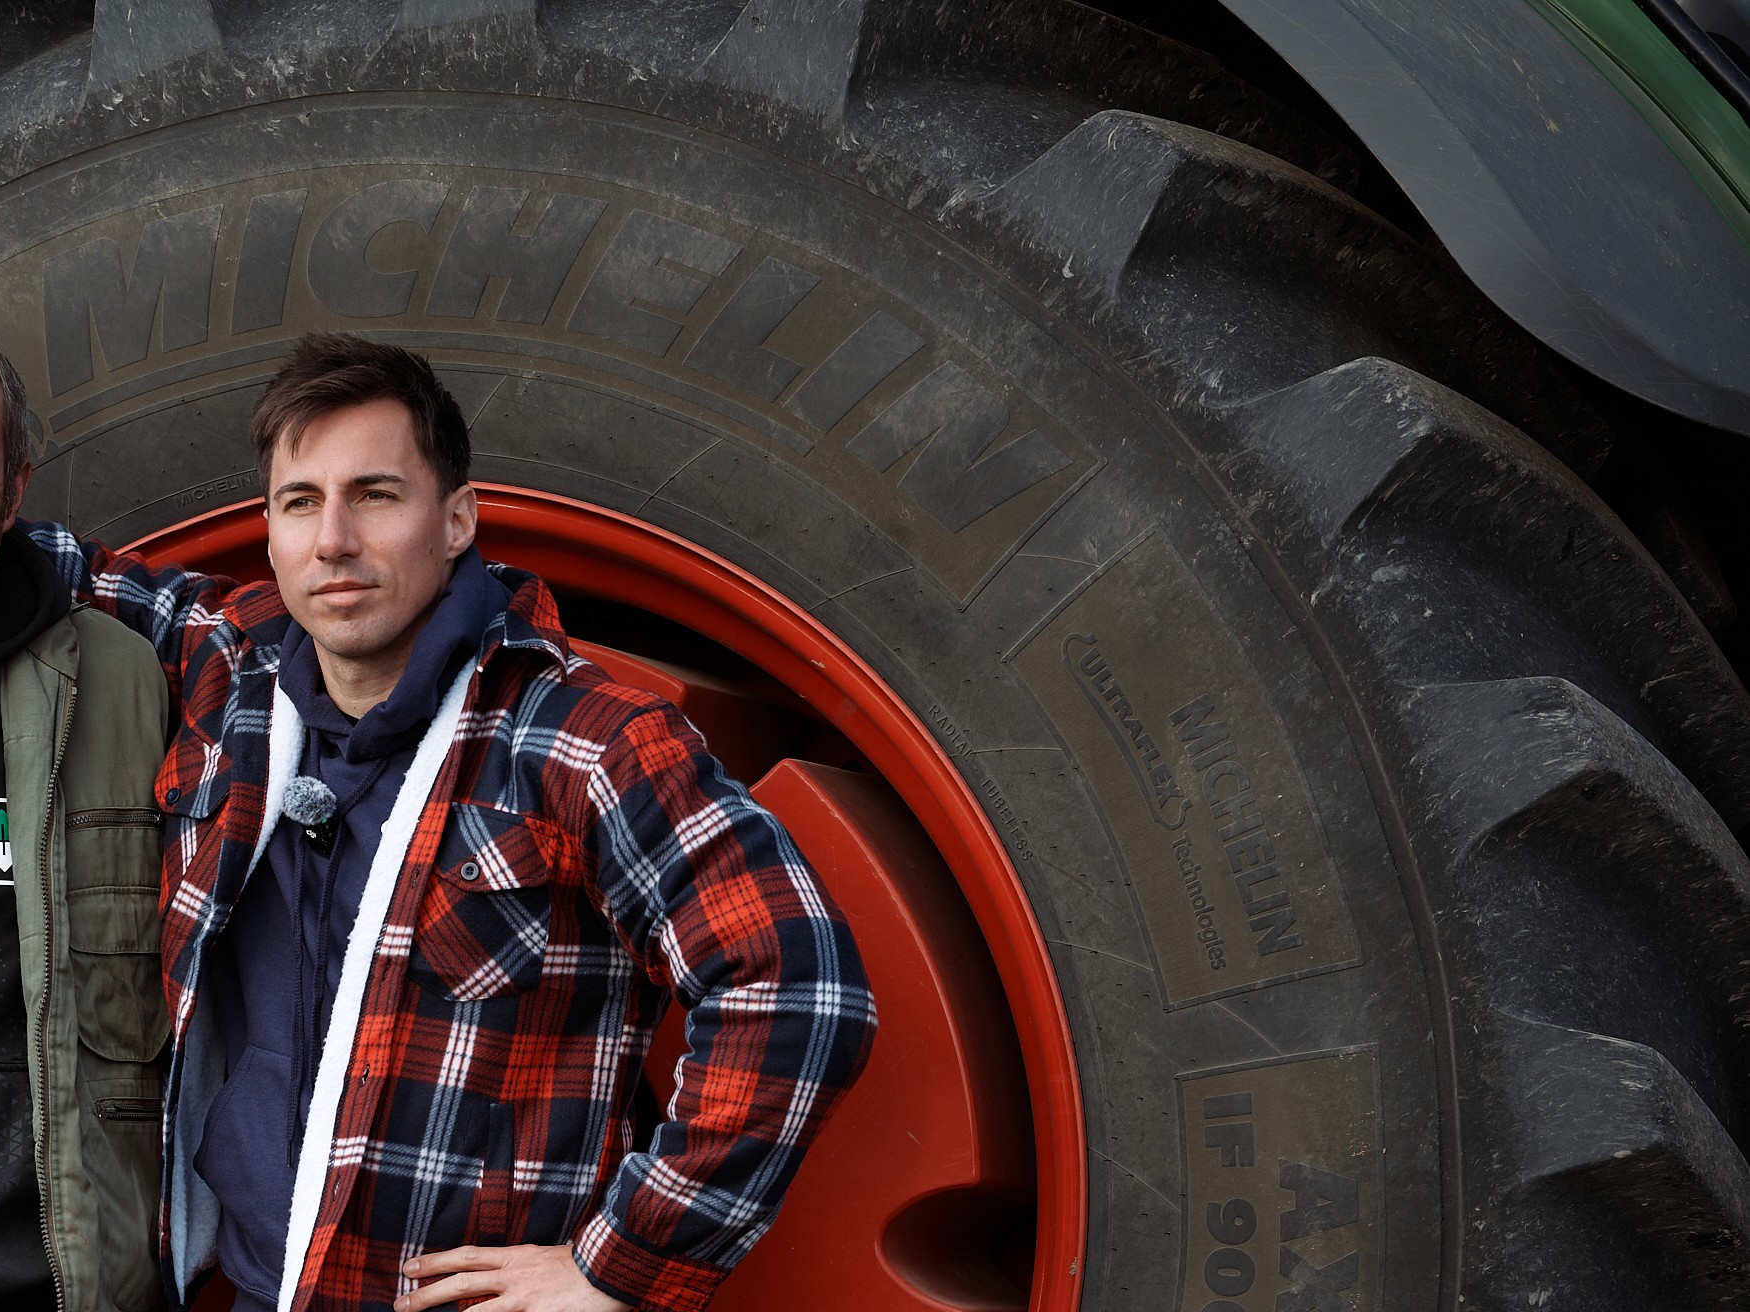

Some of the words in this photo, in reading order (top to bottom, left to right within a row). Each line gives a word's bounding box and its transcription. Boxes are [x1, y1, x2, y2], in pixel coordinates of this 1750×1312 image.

[43, 179, 1072, 534] MICHELIN
[1079, 647, 1184, 808] ULTRAFLEX
[1171, 831, 1226, 971] Technologies
[1168, 694, 1303, 957] MICHELIN
[1204, 1092, 1254, 1168] IF
